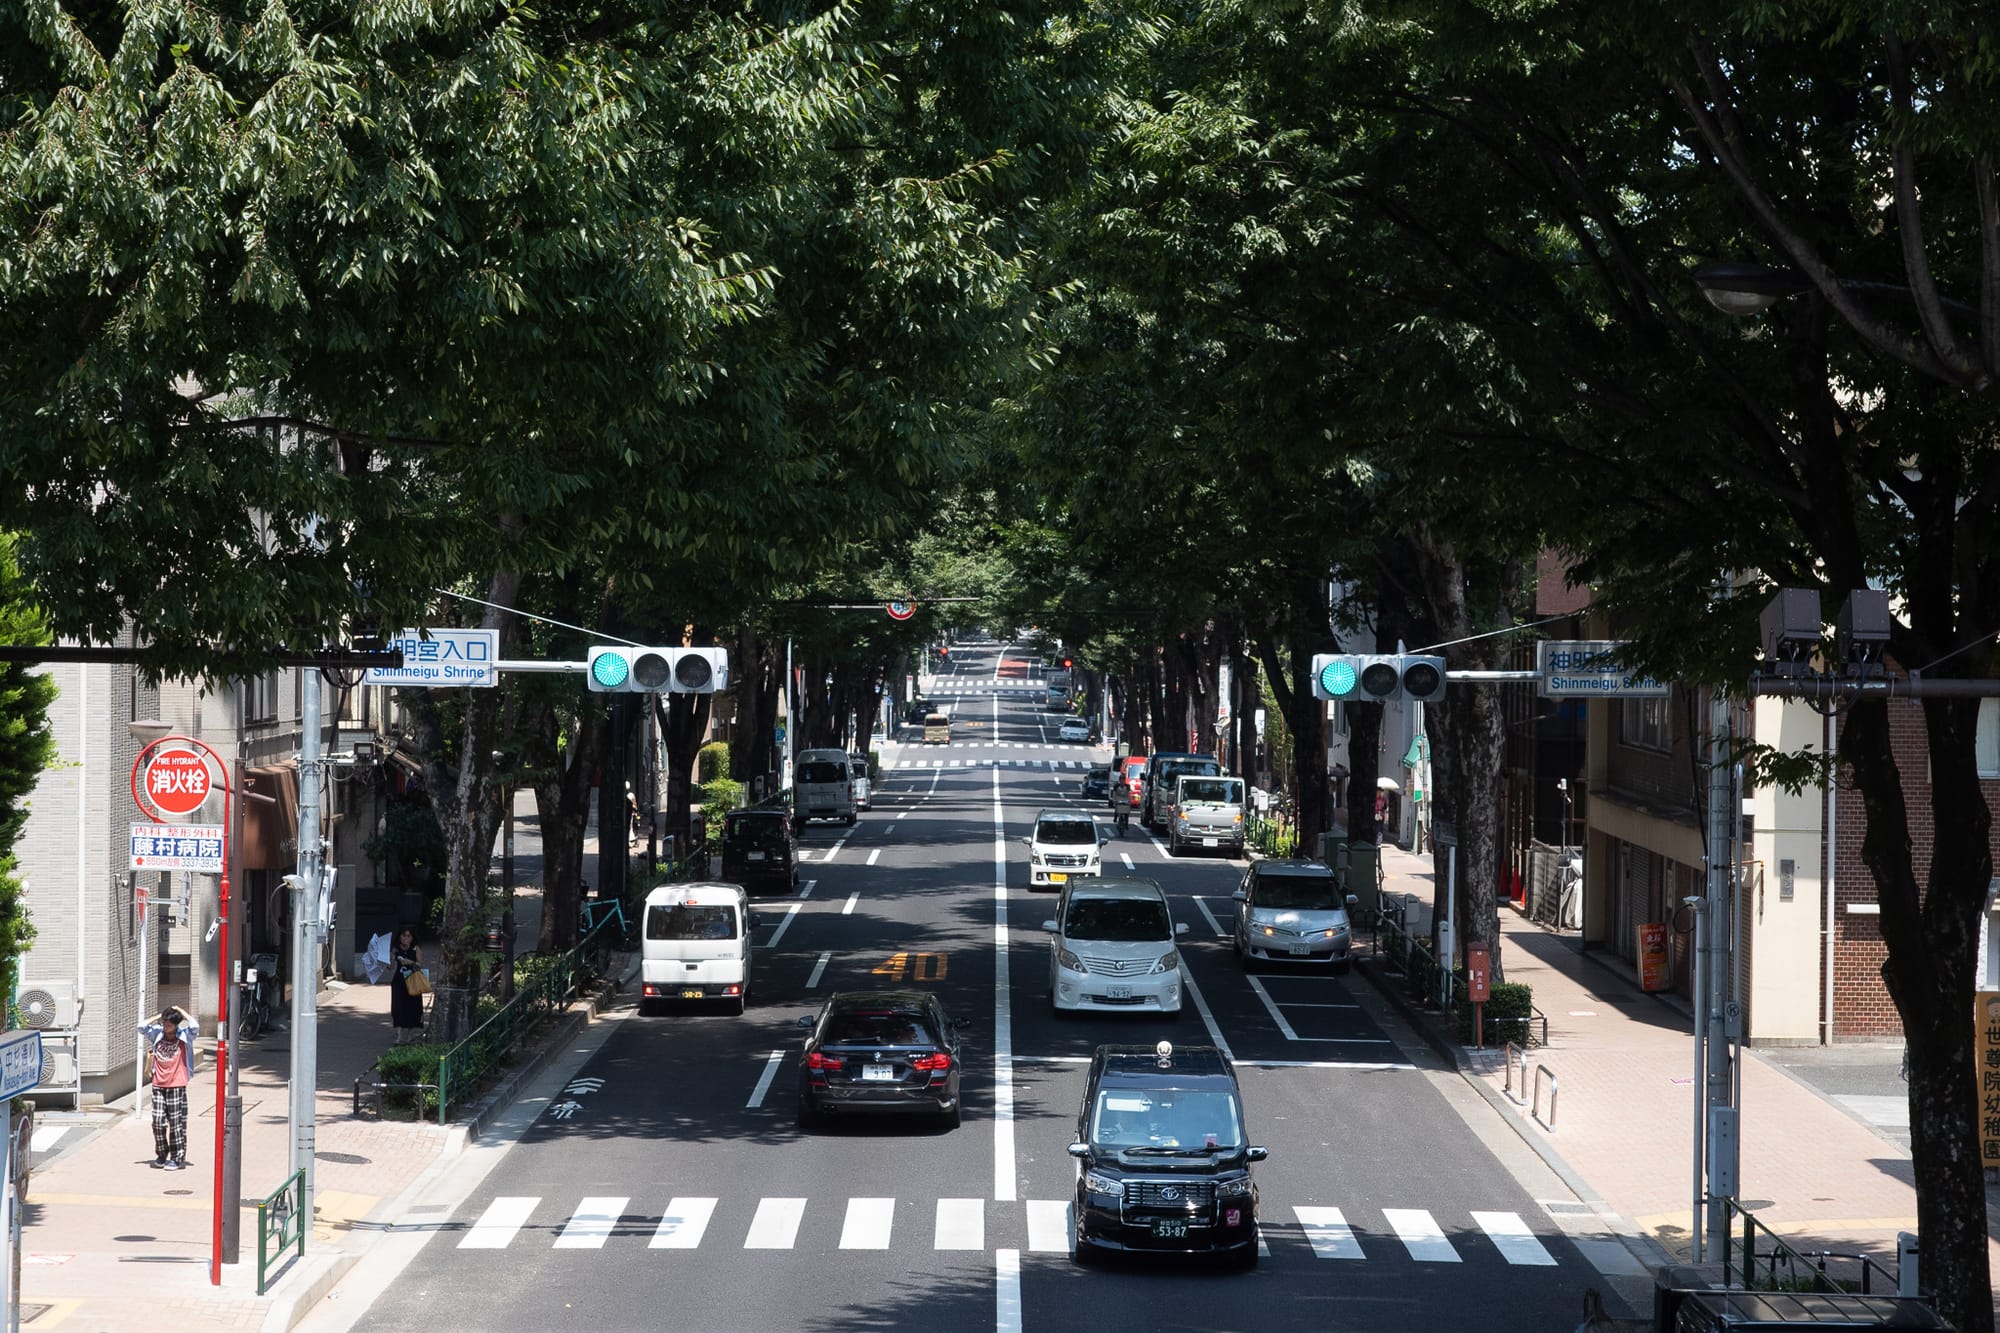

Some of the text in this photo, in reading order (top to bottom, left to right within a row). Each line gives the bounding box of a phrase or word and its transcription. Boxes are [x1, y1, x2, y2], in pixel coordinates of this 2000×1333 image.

[372, 639, 487, 661] 明宮入口
[373, 664, 485, 679] Shinmeigu Shrine
[1551, 676, 1617, 690] Shinmeigu
[156, 757, 200, 765] FIRE HYDRANT
[151, 768, 206, 794] 消火栓
[134, 827, 218, 838] 内科 整形外科
[133, 837, 220, 857] 藤村病院
[181, 858, 219, 868] 3337-3934
[871, 951, 948, 981] 40
[5, 1041, 35, 1076] 中杉通り
[1983, 1025, 2000, 1160] 世尊院幼稚園
